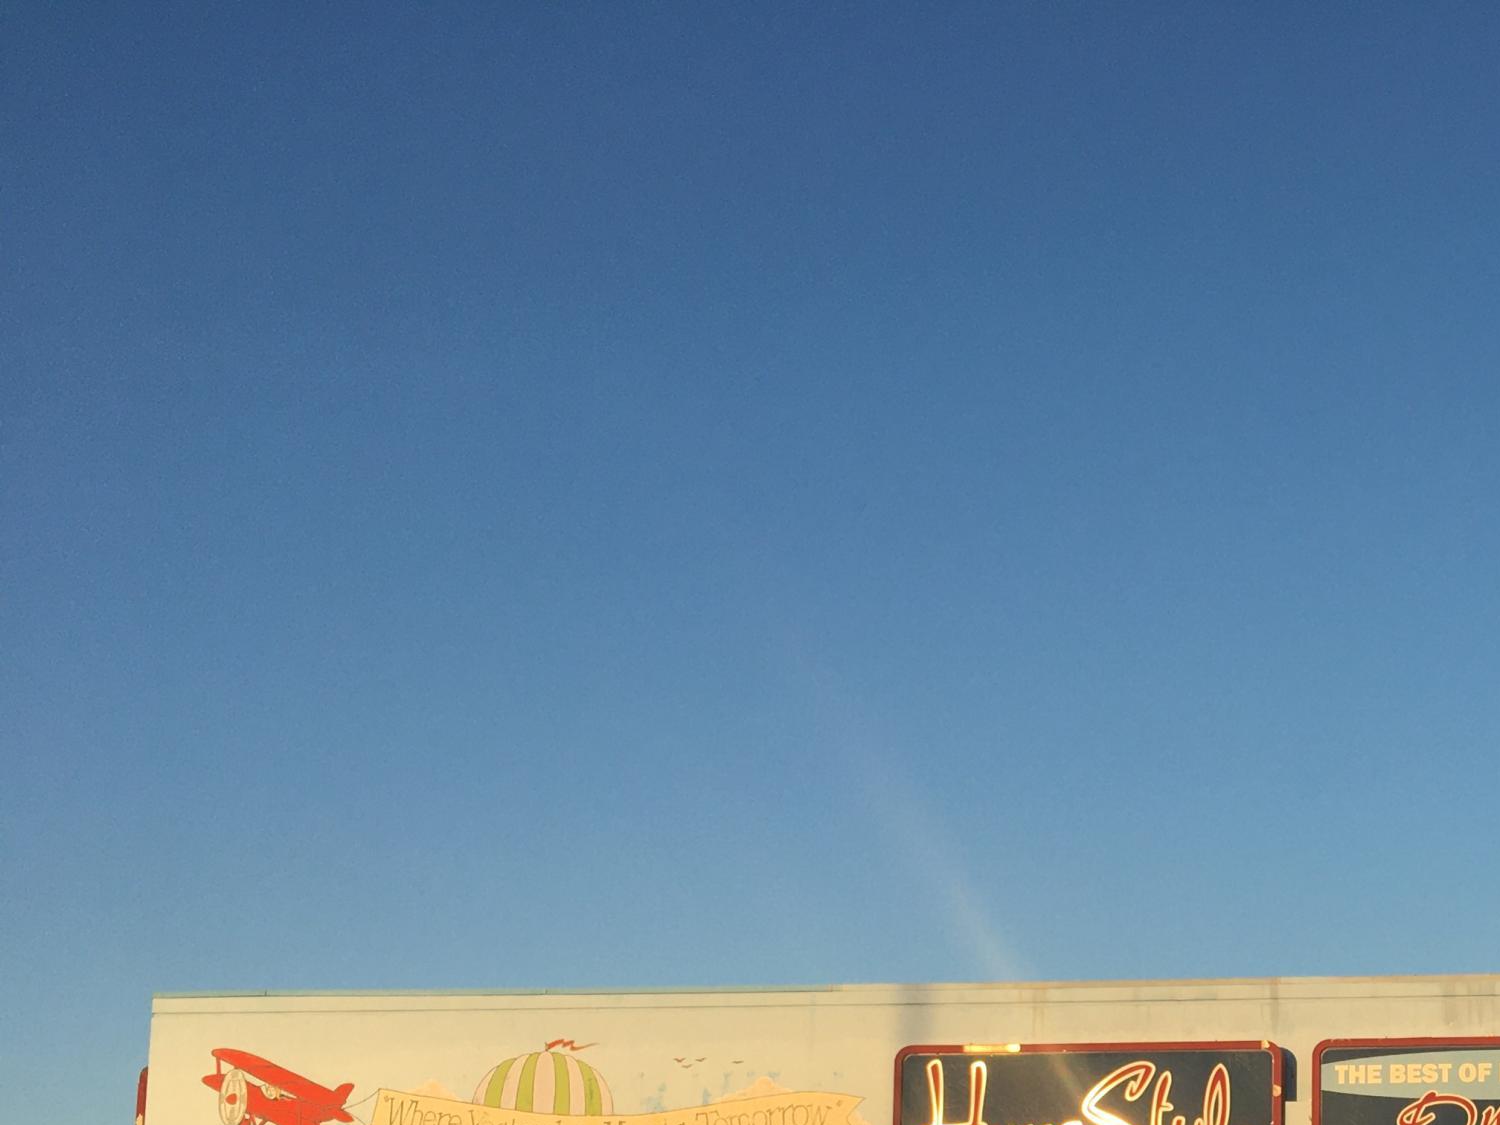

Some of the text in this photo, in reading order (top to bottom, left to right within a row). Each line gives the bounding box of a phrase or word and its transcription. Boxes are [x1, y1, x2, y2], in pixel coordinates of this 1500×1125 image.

[1334, 1064, 1383, 1084] THE
[1389, 1063, 1452, 1084] BEST
[1458, 1062, 1492, 1083] OF
